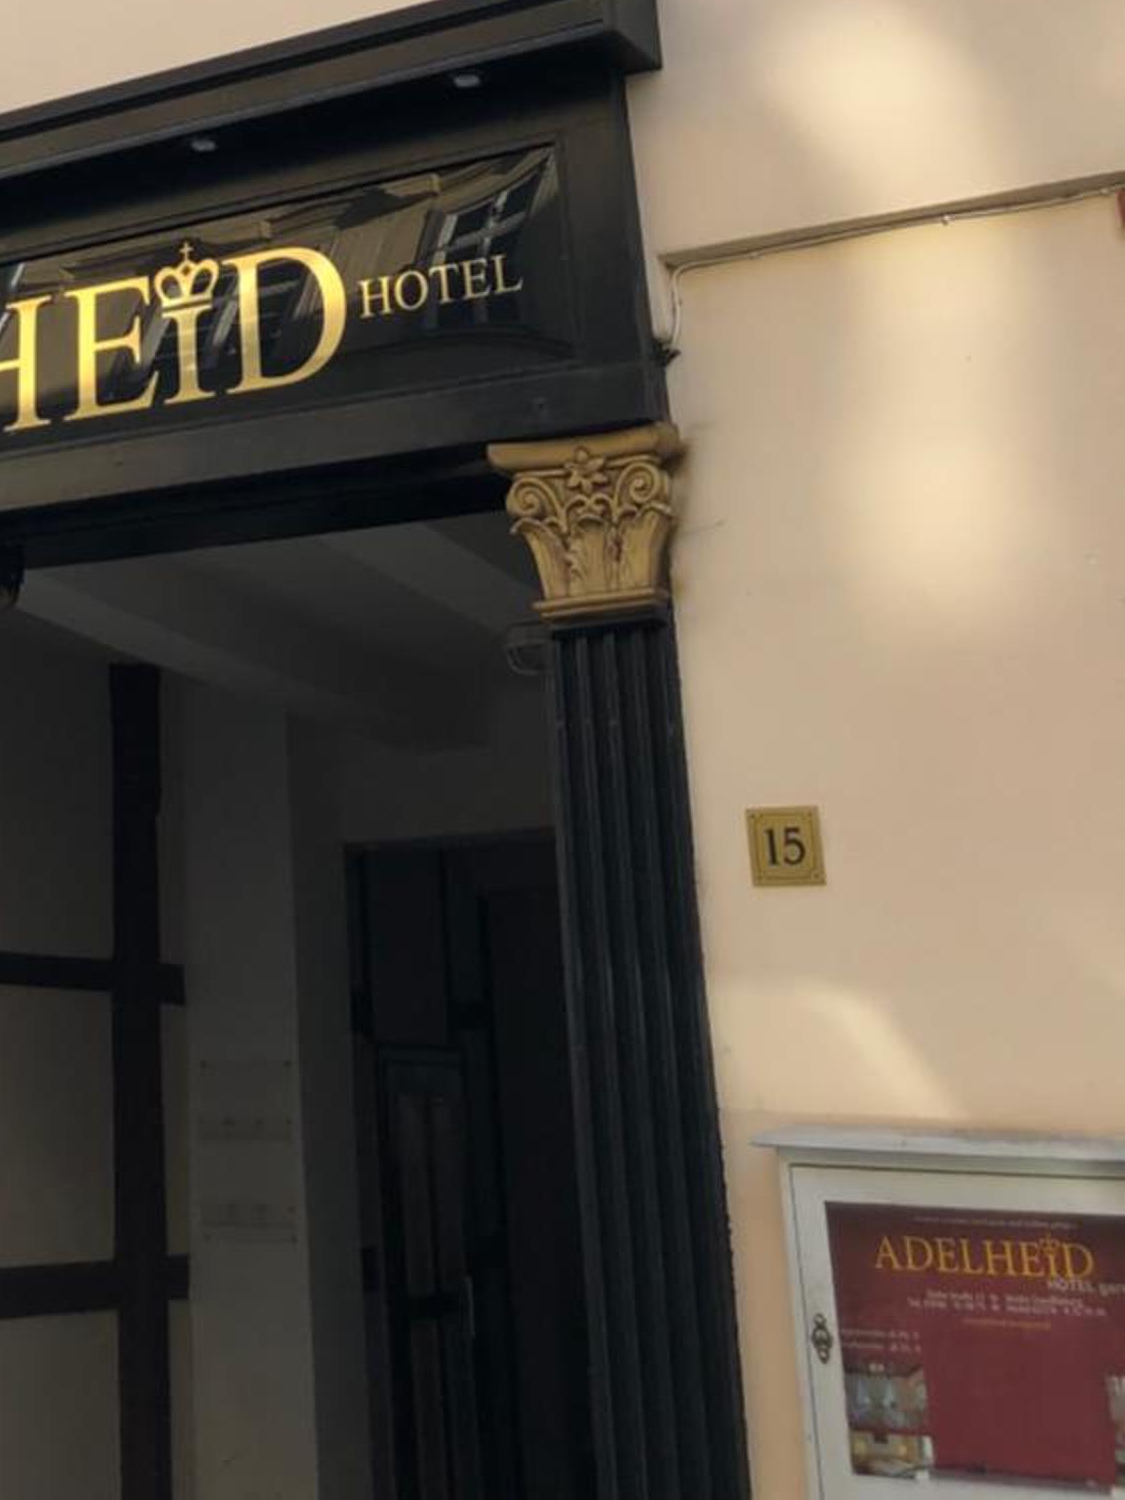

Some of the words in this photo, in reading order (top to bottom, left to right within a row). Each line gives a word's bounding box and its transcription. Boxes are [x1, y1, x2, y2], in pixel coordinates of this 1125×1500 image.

[357, 254, 523, 320] HOTEL
[763, 826, 806, 867] 15
[874, 1232, 1095, 1281] ADELHEID
